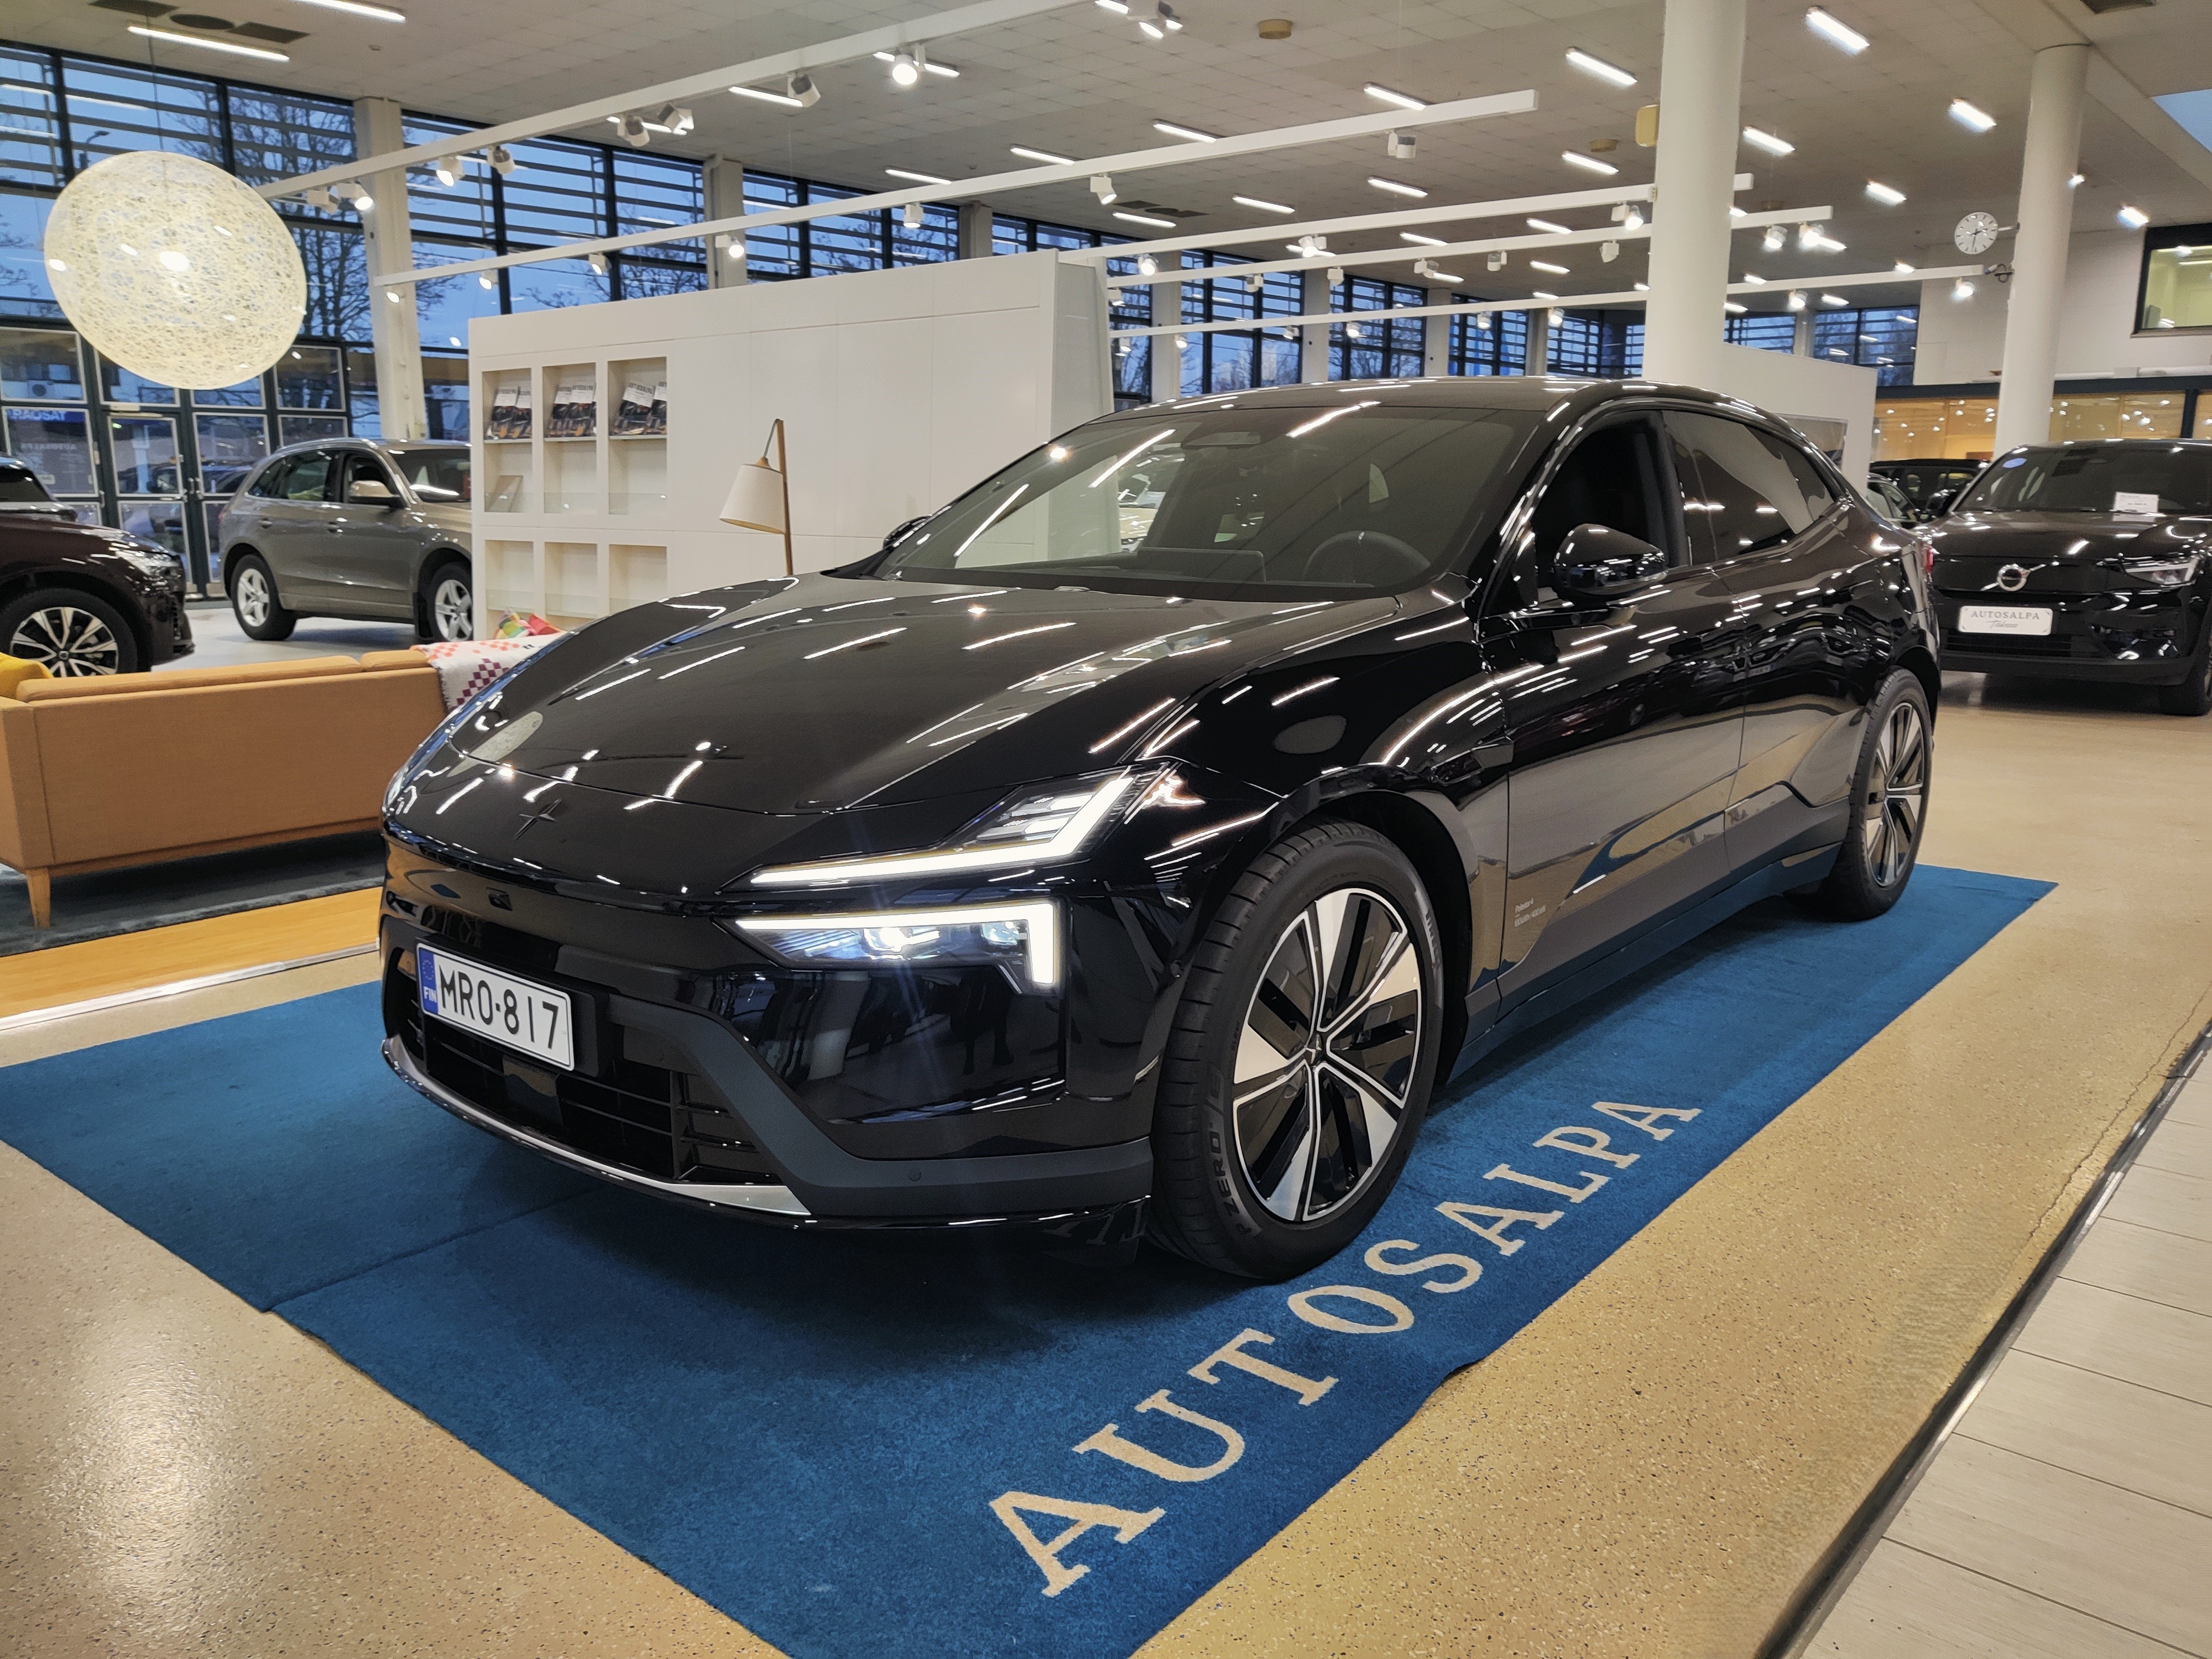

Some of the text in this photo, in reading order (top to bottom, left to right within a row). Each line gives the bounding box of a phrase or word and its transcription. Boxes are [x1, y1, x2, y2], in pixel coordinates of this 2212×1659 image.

[1970, 611, 2041, 620] AUTOSALPA
[424, 986, 437, 1003] FIN
[439, 964, 559, 1049] MRO-817
[1209, 1131, 1240, 1217] ZERO
[989, 1100, 1702, 1598] AUTOSALPA
